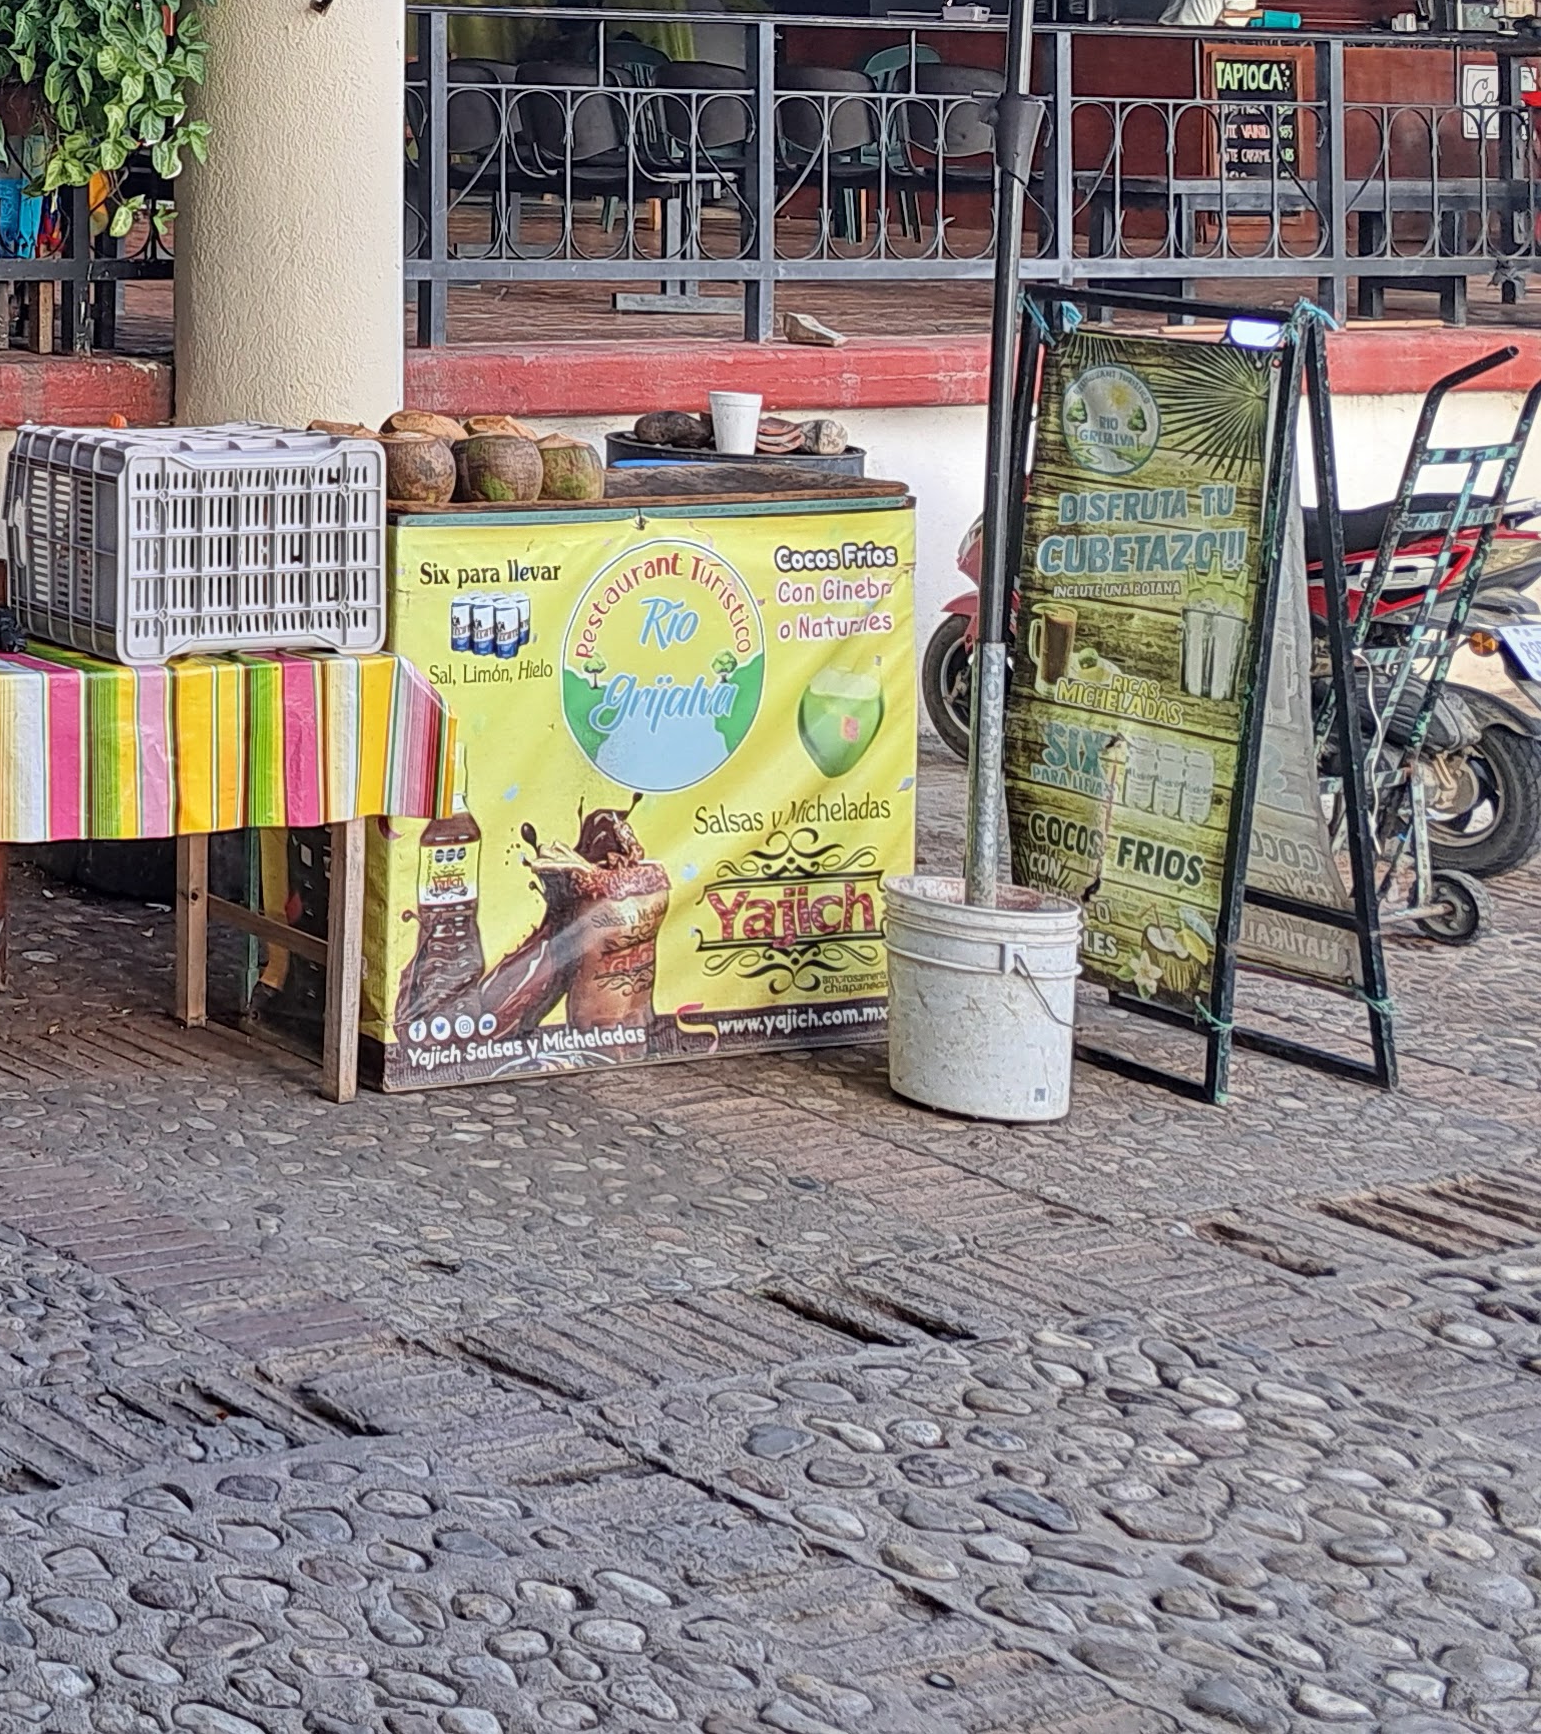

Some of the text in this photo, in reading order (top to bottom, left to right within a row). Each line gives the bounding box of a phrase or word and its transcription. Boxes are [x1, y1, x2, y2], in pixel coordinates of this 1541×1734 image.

[1215, 61, 1284, 91] TAPIOCA
[1059, 484, 1236, 525] DISFRUTA TU
[774, 540, 899, 573] Cocos Fríos
[419, 558, 562, 590] Six para llevar
[1053, 580, 1181, 598] INCLUYE UNA BOTANA
[574, 552, 685, 660] Restaurant
[777, 580, 815, 604] Con
[779, 624, 791, 640] o
[428, 658, 554, 687] Sal, Limón, Hielo
[1111, 673, 1160, 698] RICAS
[1055, 676, 1184, 726] MICHELADAS
[1041, 720, 1112, 780] SIX
[1031, 762, 1069, 788] PARA
[693, 792, 892, 836] Salsas y Micheladas
[1028, 810, 1105, 861] COCOS
[706, 881, 876, 948] Yajich
[717, 1004, 890, 1038] www.yajich.com.mx
[407, 1023, 647, 1072] Yajich Salsas y Micheladas
